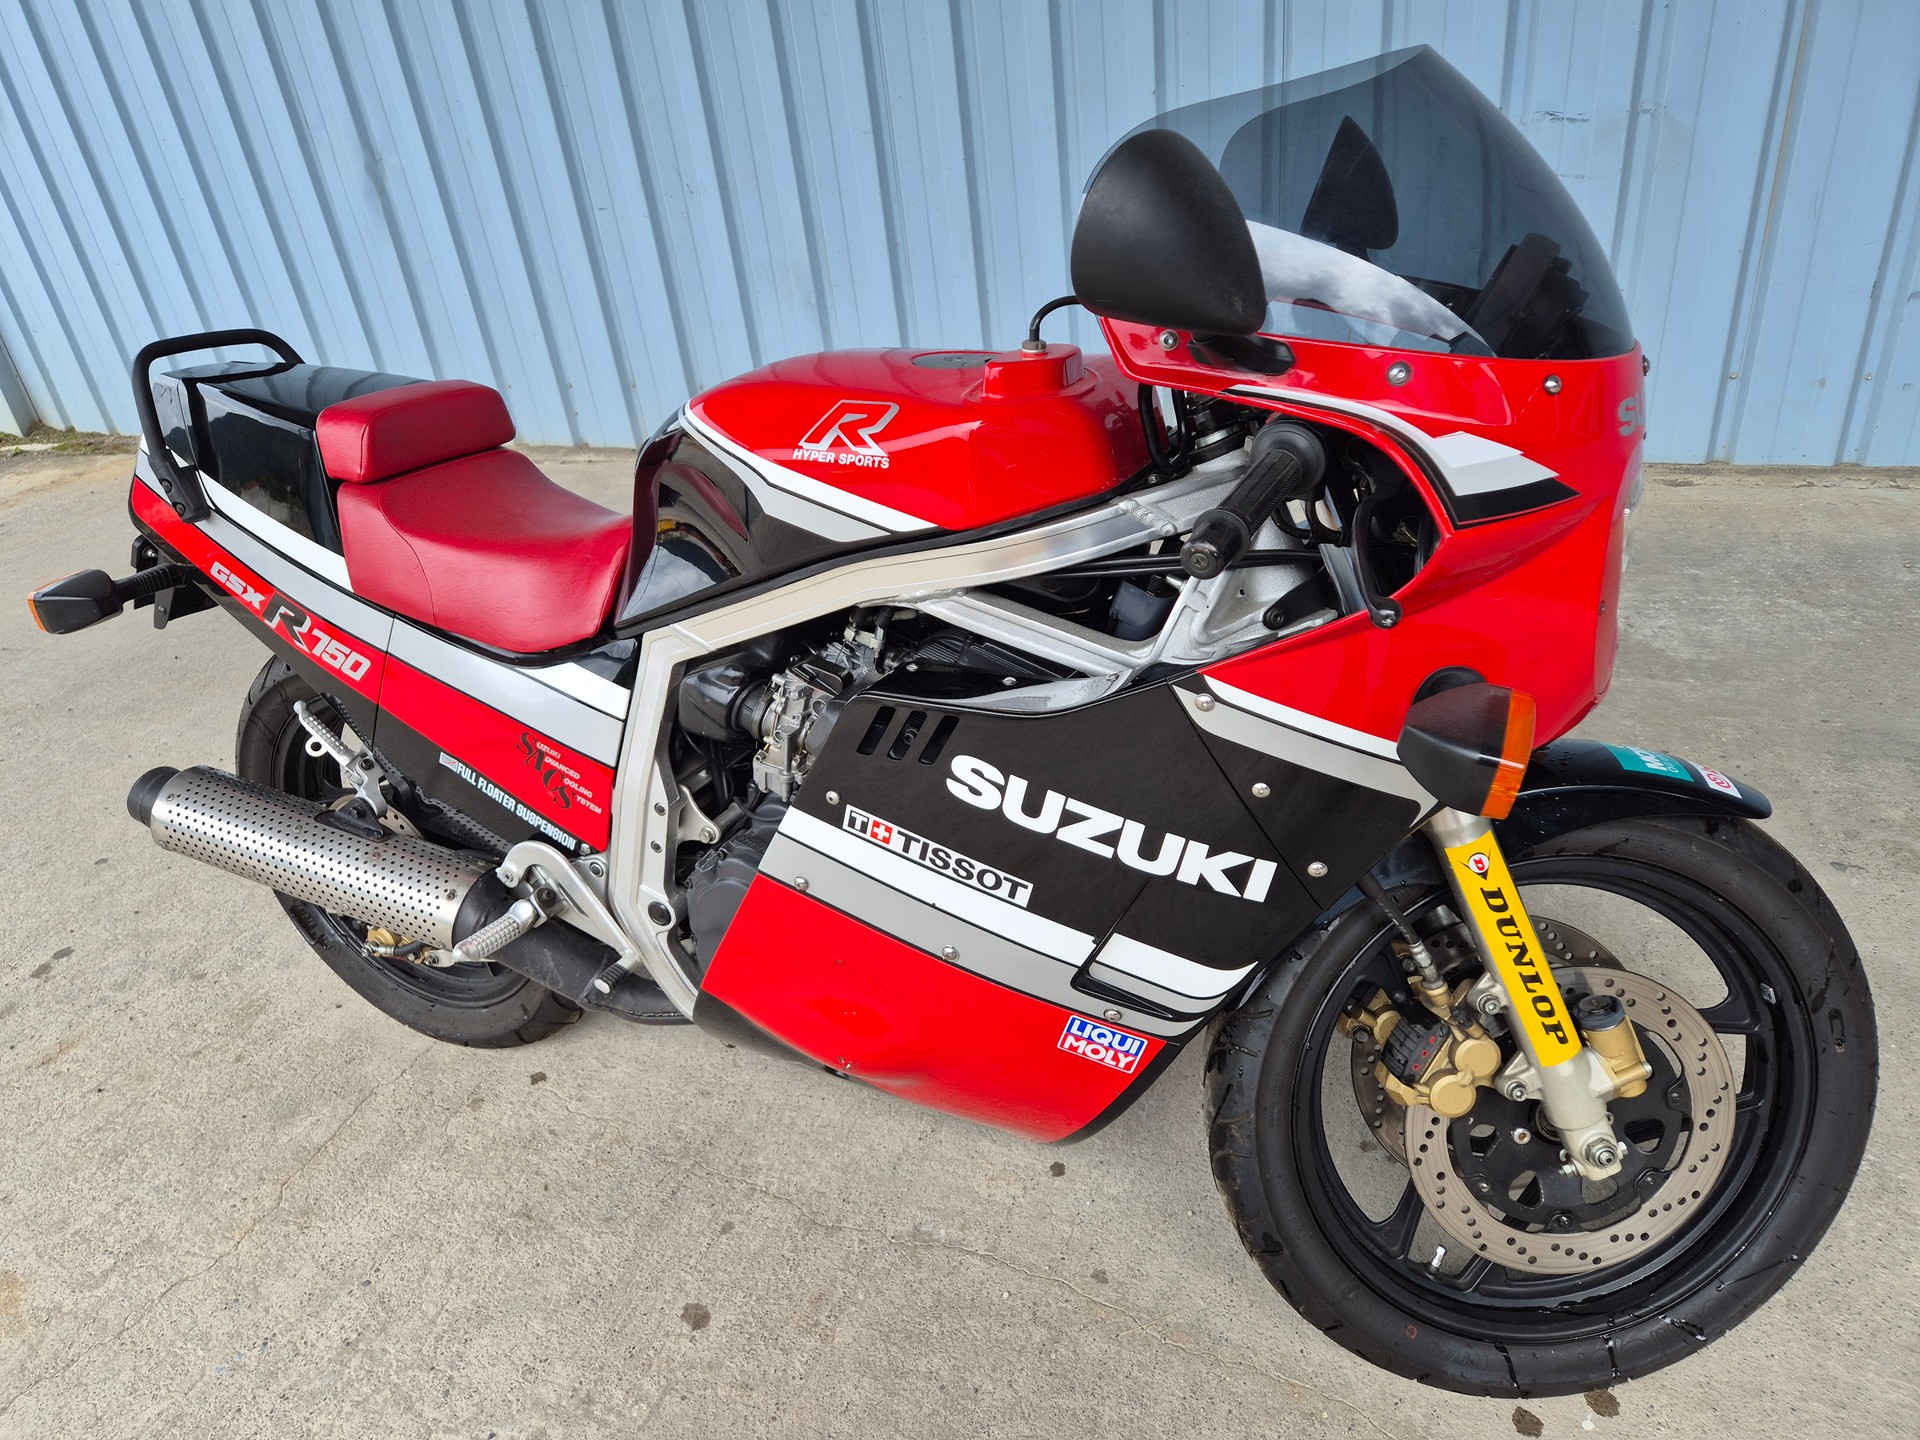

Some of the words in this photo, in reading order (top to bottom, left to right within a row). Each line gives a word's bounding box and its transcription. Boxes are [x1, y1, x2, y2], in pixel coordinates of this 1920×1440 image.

[792, 448, 836, 464] HYPER
[838, 453, 891, 469] SPORTS
[210, 560, 266, 610] GSX
[311, 627, 372, 682] 750
[456, 762, 477, 786] FULL
[477, 776, 517, 812] FLOATER
[515, 803, 577, 852] SUSPENSION
[945, 754, 1278, 903] SUZUKI
[896, 829, 1030, 903] TISSOT
[1480, 886, 1569, 1045] DUNLOP
[1062, 1034, 1136, 1069] MOLY
[1069, 1019, 1141, 1055] LIQUI
